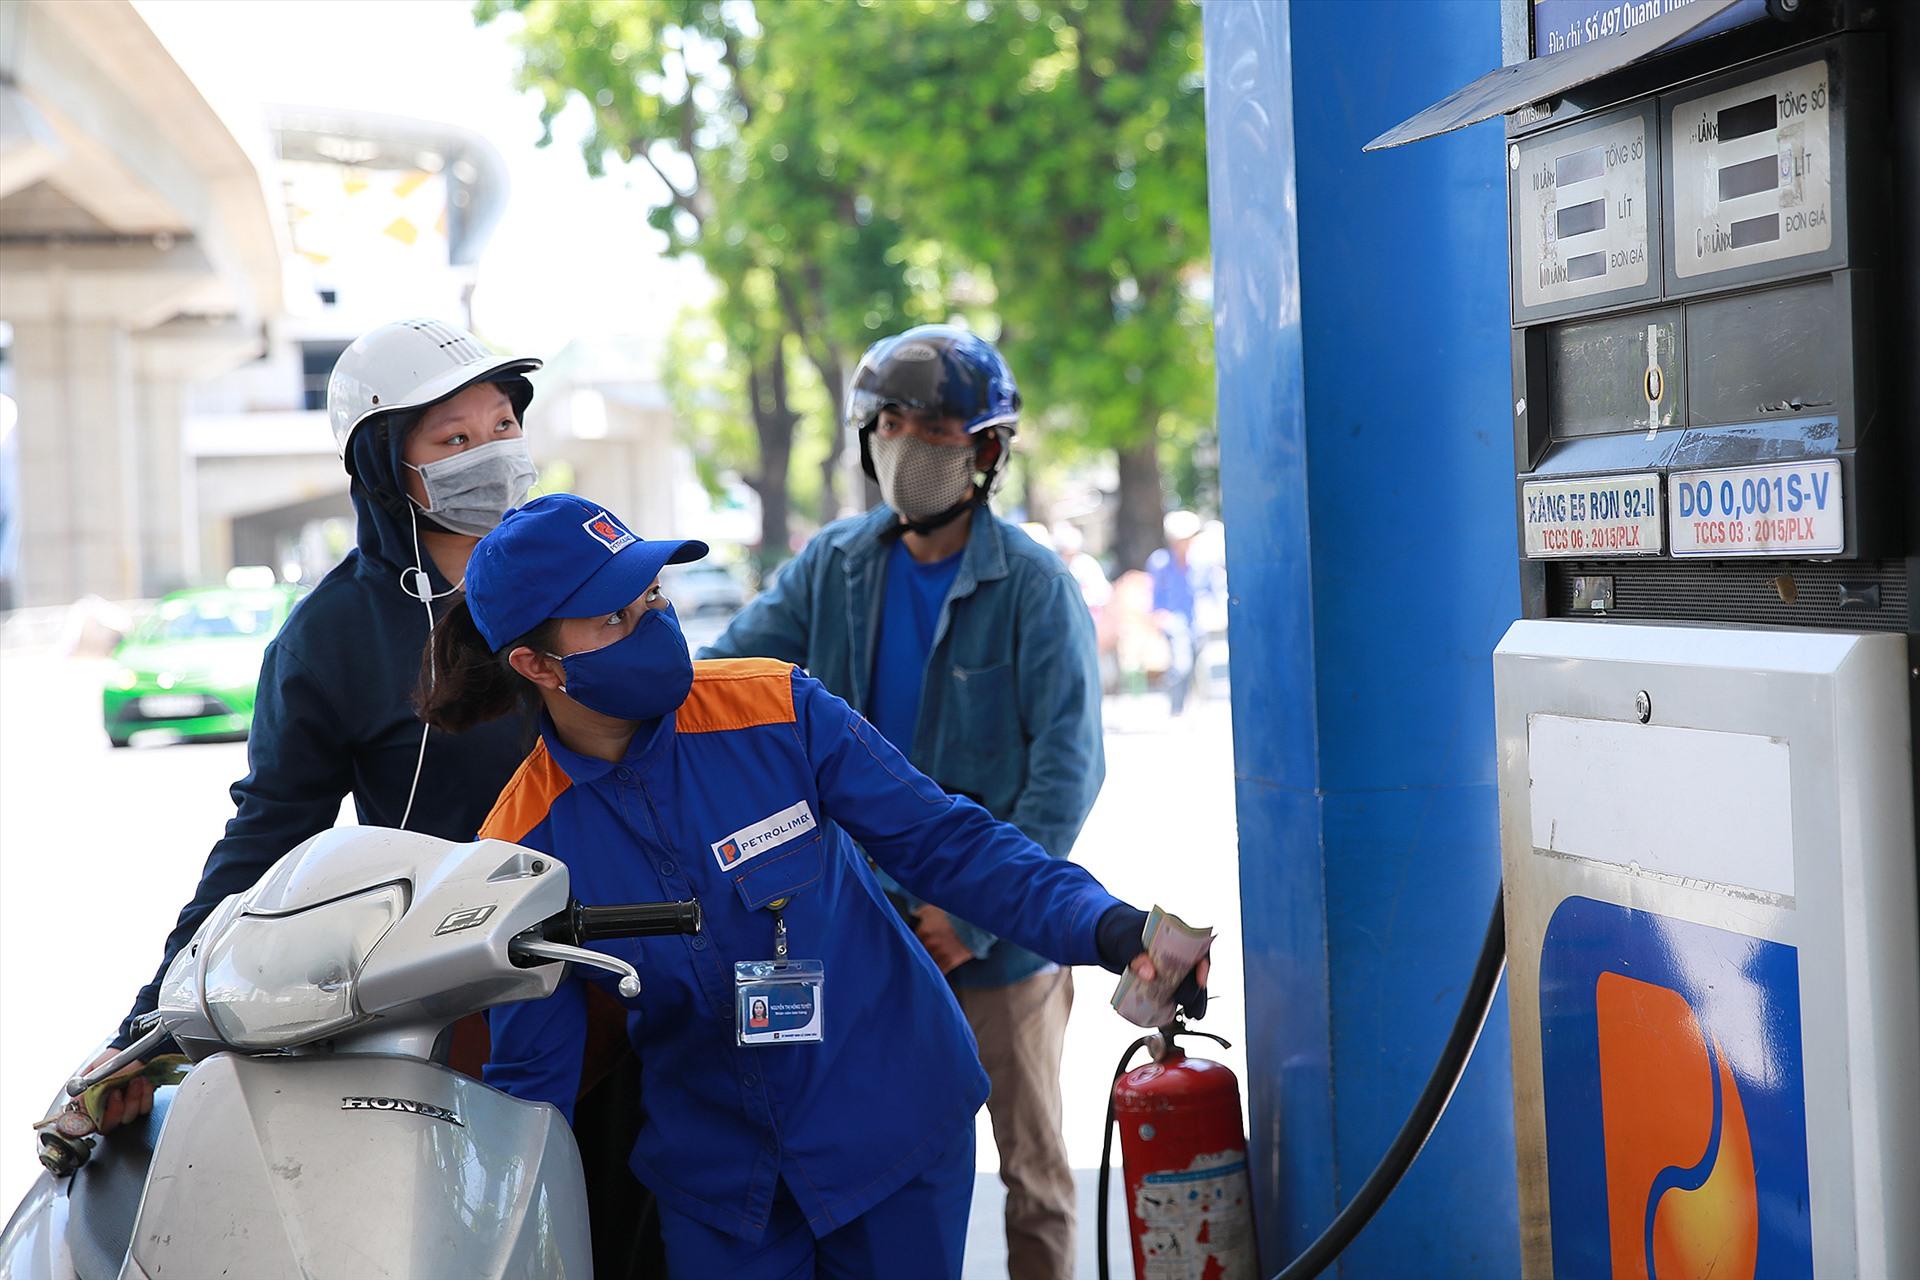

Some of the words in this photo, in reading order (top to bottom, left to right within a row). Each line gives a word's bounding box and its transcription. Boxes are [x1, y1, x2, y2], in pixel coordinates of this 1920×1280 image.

[1585, 10, 1599, 43] Số
[1600, 7, 1621, 36] 497
[1520, 102, 1551, 125] TATSUNO
[1779, 91, 1807, 120] TỔNG
[1811, 82, 1826, 111] SỐ
[1605, 142, 1628, 168] TỔNG
[1631, 135, 1644, 161] SỐ
[1795, 148, 1811, 178] LÍT
[1618, 193, 1632, 219] LÍT
[1809, 204, 1827, 227] GIÁ
[1629, 243, 1644, 264] GIÁ
[1528, 490, 1566, 523] XĂNG
[1570, 493, 1586, 521] E5
[1590, 490, 1620, 520] RON
[1624, 487, 1655, 518] 92-II
[1679, 480, 1713, 517] DO
[1720, 472, 1829, 520] 0,001S-V
[1542, 528, 1568, 550] TCCS
[1571, 529, 1583, 549] 06
[1591, 525, 1640, 549] 2015/PLX
[1693, 521, 1725, 544] TCCS
[1729, 521, 1744, 543] 03
[1755, 517, 1814, 543] 2015/PLX
[741, 813, 810, 851] PETROLIMEX
[341, 1096, 465, 1128] HONDA
